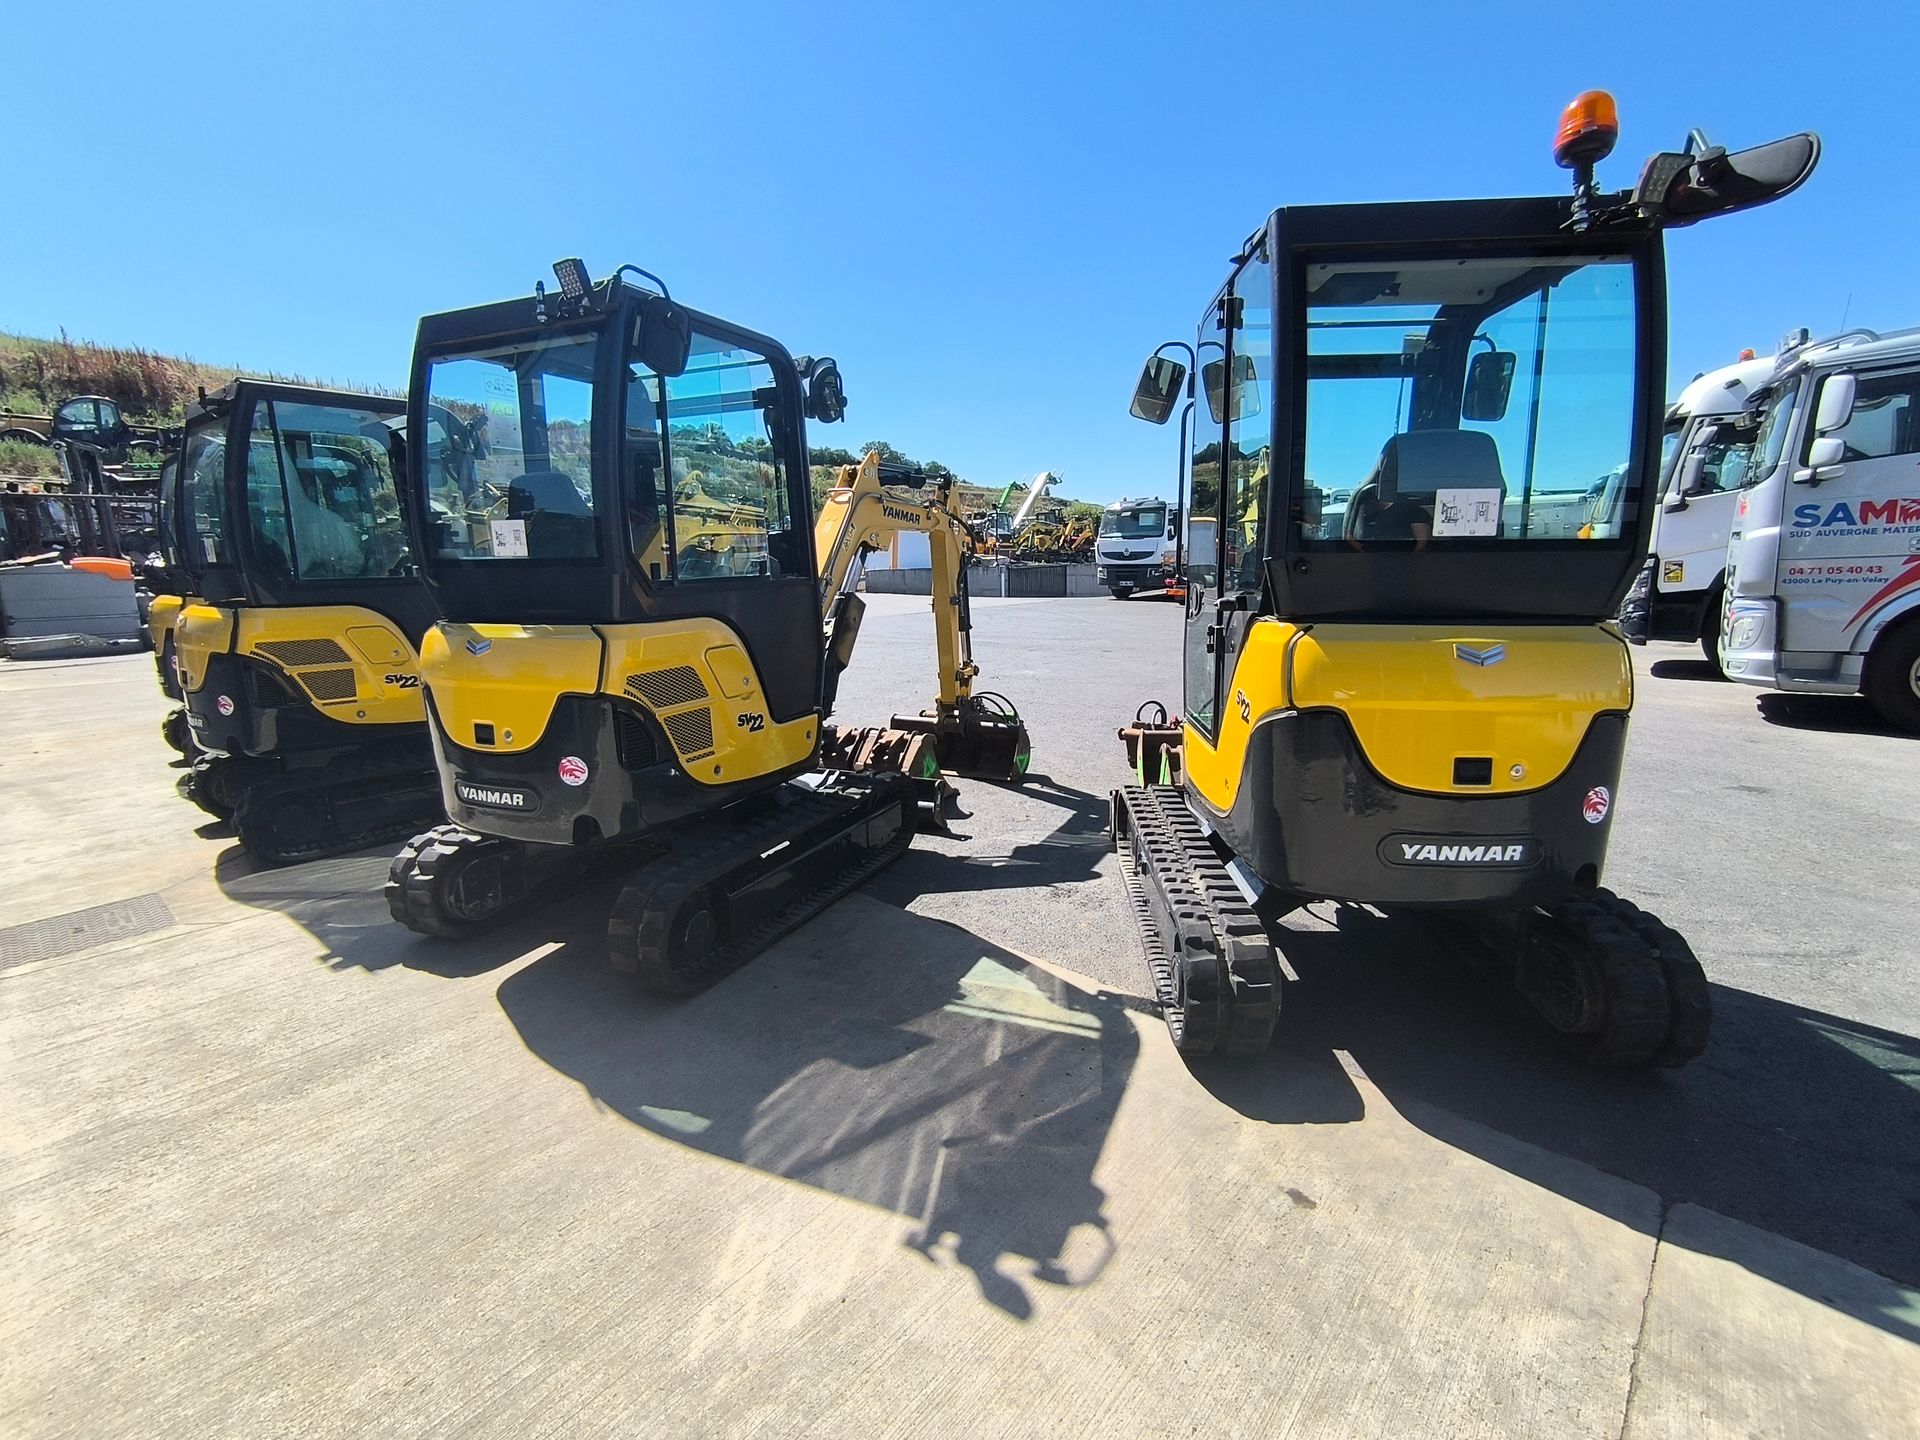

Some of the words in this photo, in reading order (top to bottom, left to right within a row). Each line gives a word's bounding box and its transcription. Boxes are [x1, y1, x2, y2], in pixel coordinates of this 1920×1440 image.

[882, 504, 921, 525] YANMAR
[1789, 530, 1812, 538] SUD
[1816, 527, 1879, 537] AUVERGNE
[1789, 567, 1804, 576] 04
[1807, 567, 1823, 575] 71
[1827, 566, 1844, 574] 05
[1846, 566, 1863, 574] 40
[1866, 565, 1883, 573] 43
[1781, 577, 1810, 585] 43000
[385, 674, 419, 688] SV22
[737, 712, 765, 732] SV22
[460, 785, 524, 806] YANMAR
[1401, 843, 1523, 861] YANMAR
